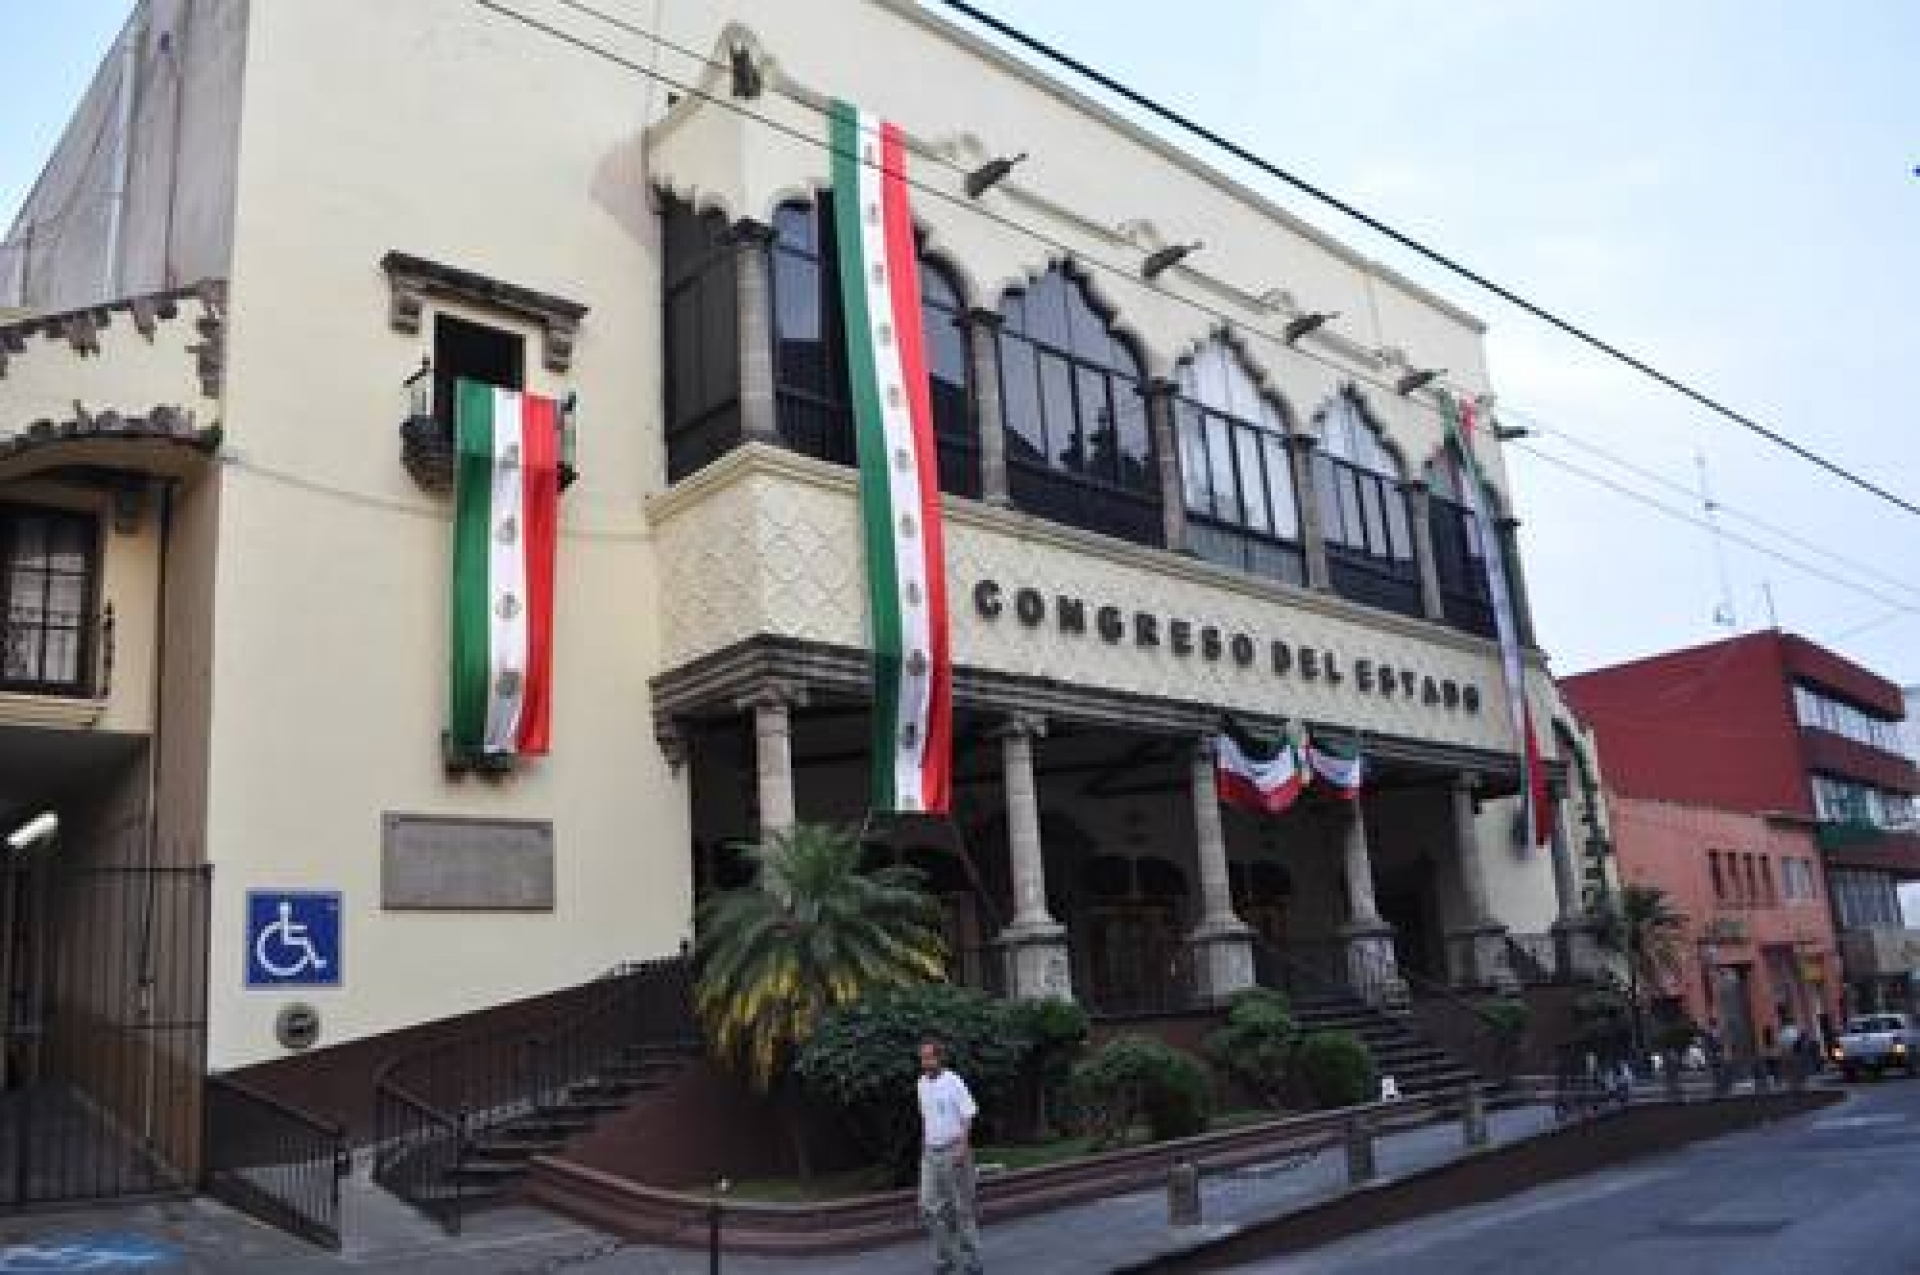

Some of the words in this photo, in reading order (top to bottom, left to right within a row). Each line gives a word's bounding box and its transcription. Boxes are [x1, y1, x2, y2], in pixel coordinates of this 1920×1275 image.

[974, 579, 1253, 667] CONGRESO
[1271, 640, 1344, 684] DEL
[1354, 657, 1480, 714] ESTADO
